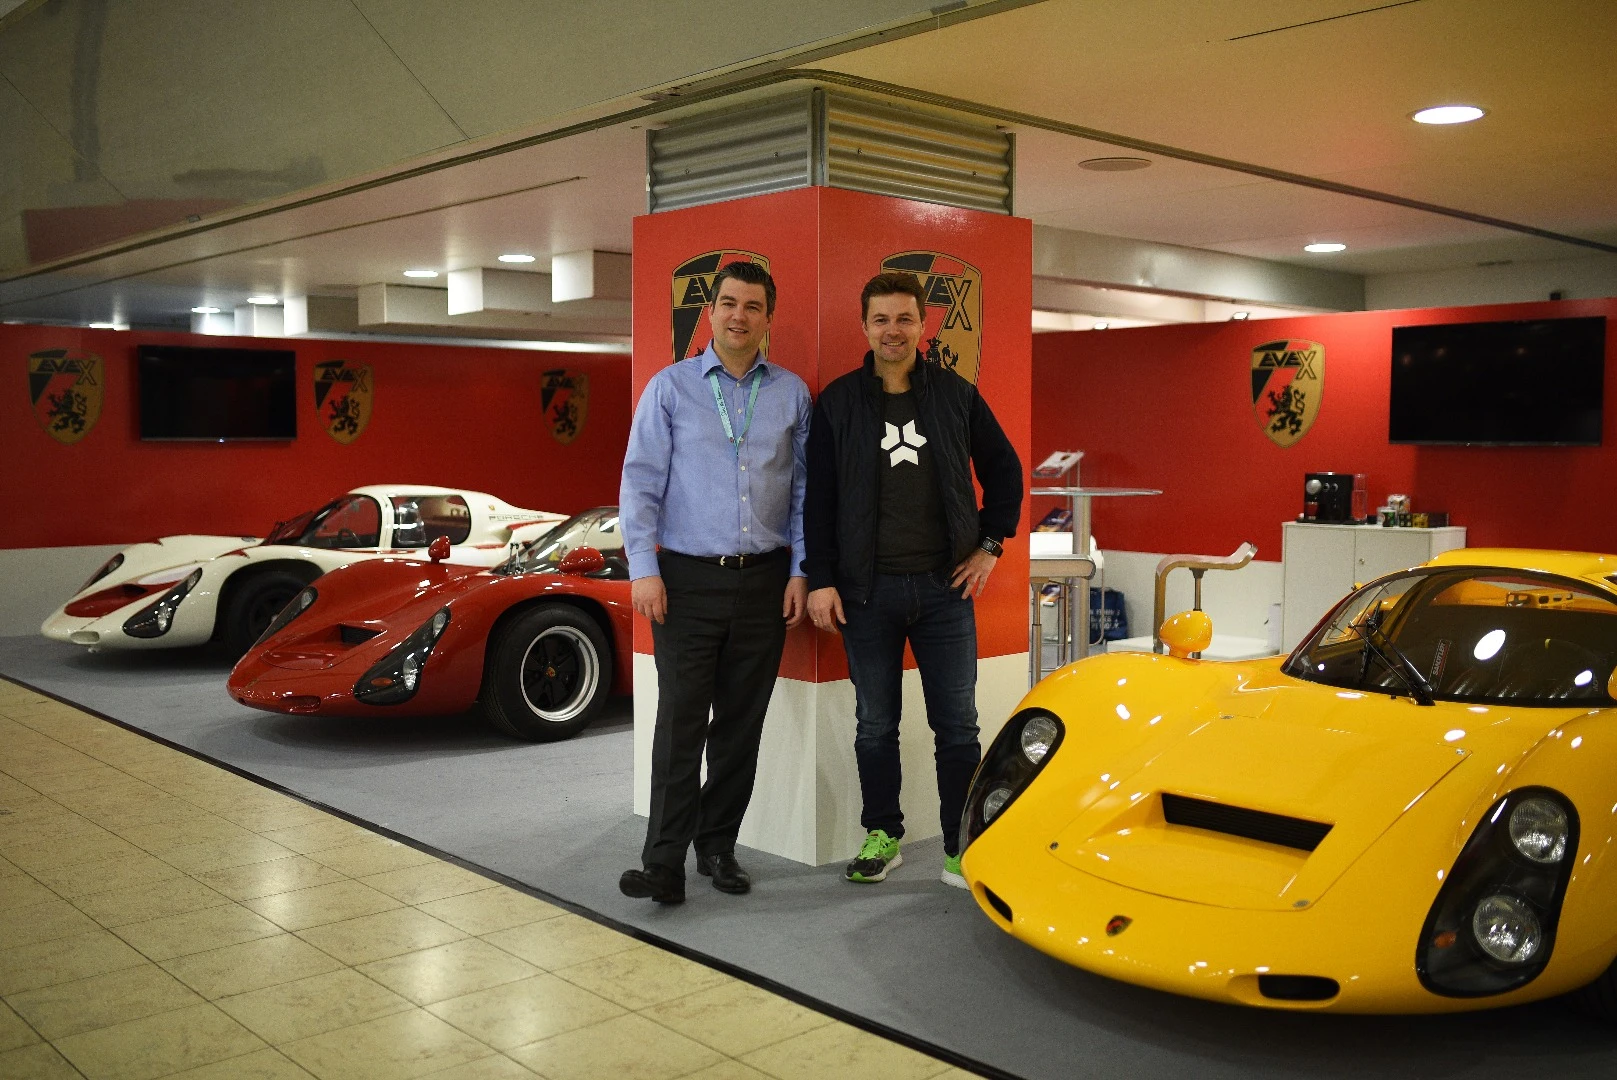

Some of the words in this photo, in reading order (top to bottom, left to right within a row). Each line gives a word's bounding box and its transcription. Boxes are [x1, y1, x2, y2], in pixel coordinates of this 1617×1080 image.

[36, 360, 97, 385] EVEX
[1259, 351, 1317, 379] EVEX
[320, 368, 368, 392] EVEX
